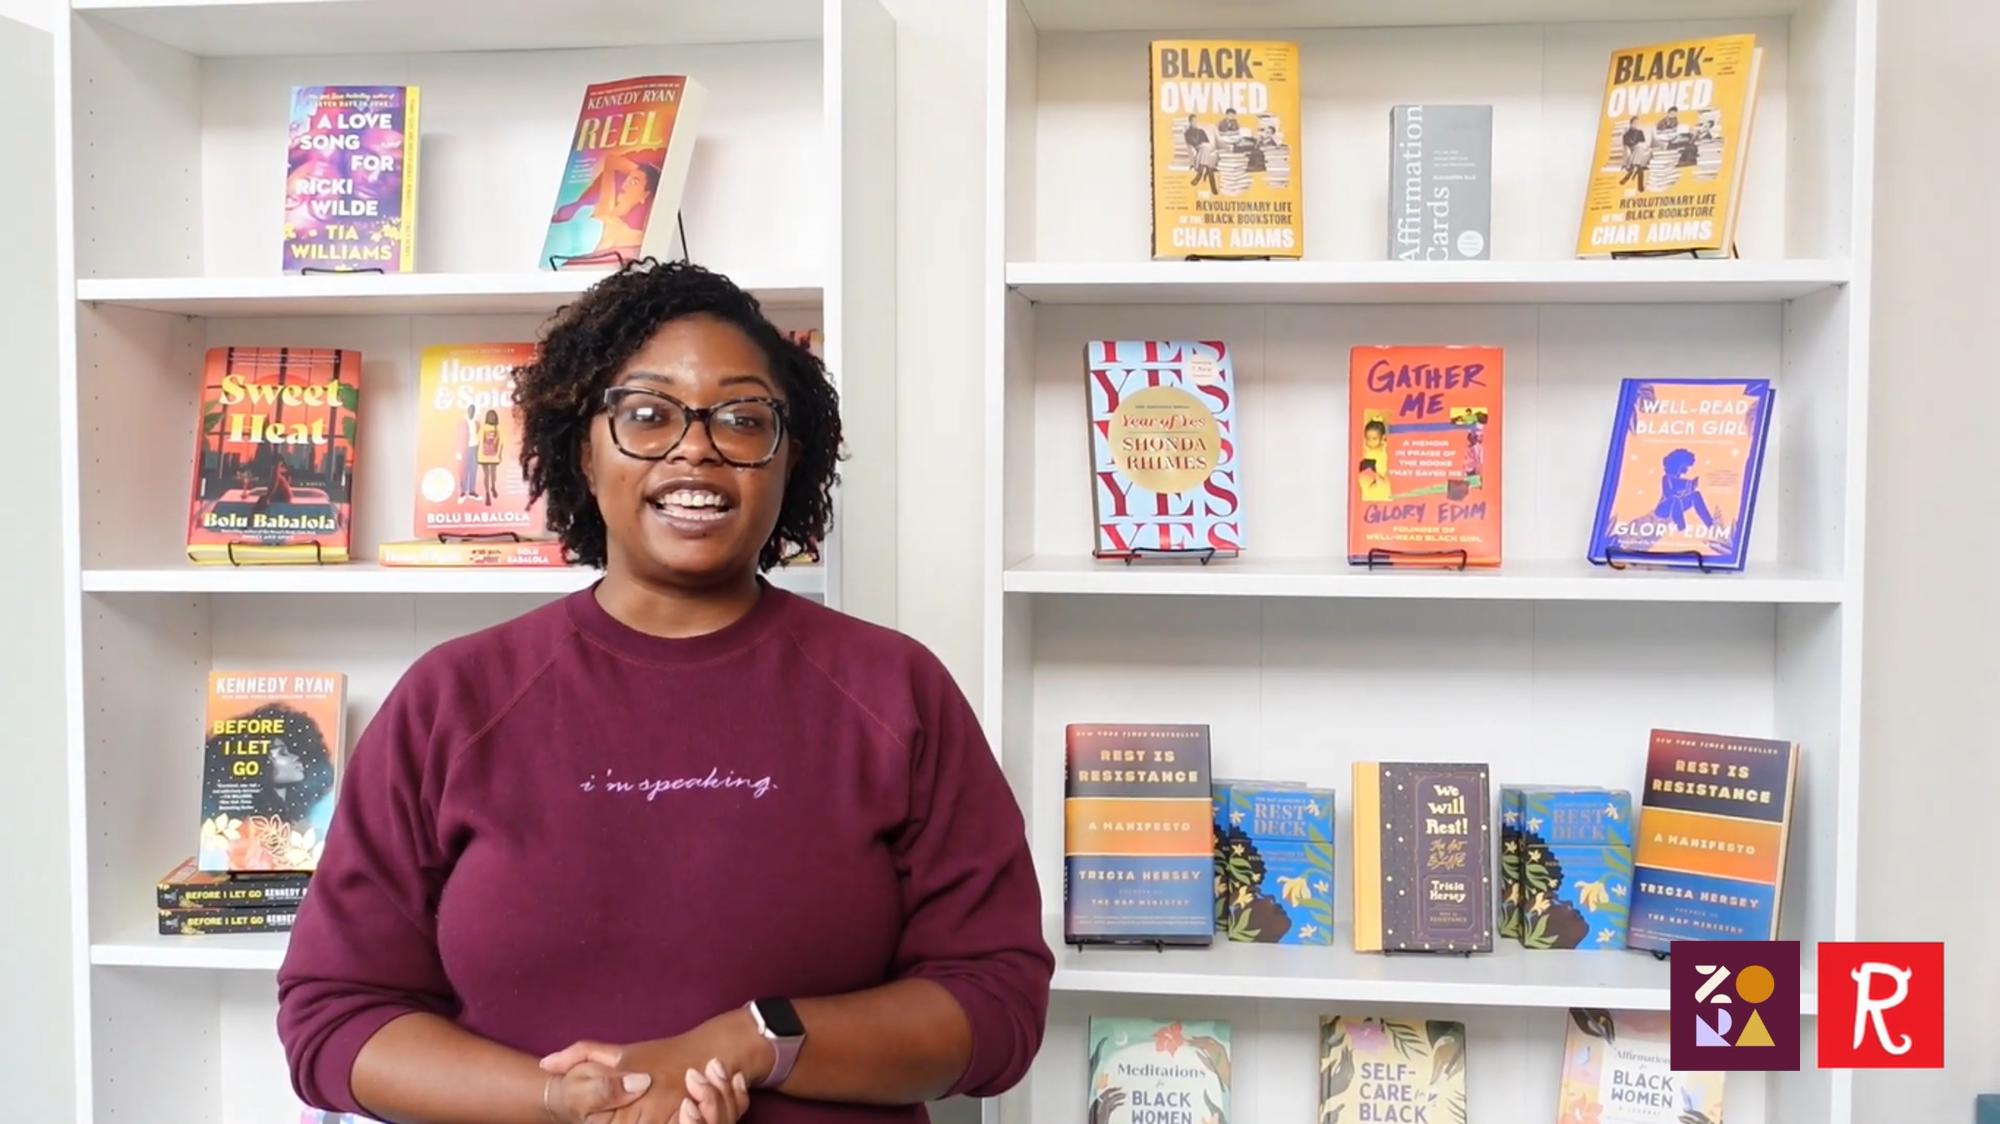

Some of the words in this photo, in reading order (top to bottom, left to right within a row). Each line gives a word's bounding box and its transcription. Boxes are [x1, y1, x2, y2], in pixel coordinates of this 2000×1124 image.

[1160, 48, 1263, 79] BLACK-
[1614, 46, 1714, 85] BLACK-
[588, 90, 641, 110] KENNEDY
[642, 89, 676, 103] RYAN
[1160, 82, 1269, 114] OWNED
[1607, 78, 1713, 118] OWNED
[317, 114, 332, 129] A
[337, 113, 392, 129] LOVE
[576, 111, 663, 152] REEL
[300, 134, 360, 150] SONG
[351, 156, 394, 171] FOR
[296, 179, 353, 194] RICKI
[1397, 105, 1422, 262] Affirmation
[1198, 190, 1210, 198] THE
[1620, 194, 1694, 208] REVOLUTIONARY
[1696, 194, 1717, 205] LIFE
[311, 200, 379, 216] WILDE
[1196, 201, 1271, 212] REVOLUTIONARY
[1273, 201, 1292, 212] LIFE
[1625, 209, 1655, 221] BLACK
[1658, 206, 1714, 218] BOOKSTORE
[1190, 215, 1203, 224] THE
[1204, 213, 1234, 224] BLACK
[1238, 214, 1292, 224] BOOKSTORE
[1426, 186, 1450, 262] Cards
[326, 225, 359, 240] TIA
[1172, 228, 1222, 248] CHAR
[1230, 228, 1294, 248] ADAMS
[1591, 225, 1640, 246] CHAR
[1646, 220, 1713, 244] ADAMS
[291, 244, 392, 260] WILLIAMS
[1367, 360, 1487, 393] GATHER
[219, 374, 343, 407] Sweet
[434, 386, 454, 410] &
[457, 385, 517, 411] Spic
[1400, 392, 1445, 419] ME
[1642, 400, 1749, 415] WELL-READ
[227, 414, 328, 444] Heat
[1122, 414, 1157, 428] Year
[1160, 413, 1178, 430] of
[1181, 414, 1206, 428] Yes
[1636, 420, 1696, 435] BLACK
[1702, 420, 1748, 436] GIRL
[1122, 437, 1207, 451] SHONDA
[1126, 456, 1208, 470] RHIMES
[426, 513, 461, 524] BOLU
[464, 512, 530, 523] BABALOLA
[1364, 503, 1426, 524] GLORY
[1438, 502, 1486, 524] EDIM
[203, 513, 248, 528] Bolu
[253, 514, 336, 530] Babalola
[1366, 534, 1424, 542] WELL-READ
[1392, 526, 1440, 534] FOUNDER
[1443, 526, 1456, 534] OF
[1614, 522, 1679, 538] GLORY
[1684, 524, 1731, 540] EDIM
[508, 556, 548, 564] BABALOLA
[516, 548, 538, 556] BOLU
[216, 677, 288, 694] KENNEDY
[294, 676, 335, 693] RYAN
[213, 719, 286, 735] BEFORE
[224, 740, 230, 755] I
[236, 740, 272, 755] LET
[1676, 739, 1696, 747] YORK
[1700, 742, 1725, 750] TIMES
[1727, 744, 1778, 755] BESTSELLER
[1100, 750, 1146, 762] REST
[1154, 750, 1176, 762] IS
[232, 761, 260, 776] GO
[1078, 770, 1199, 783] RESISTANCE
[1675, 759, 1720, 776] REST
[1727, 765, 1750, 779] IS
[1433, 785, 1460, 796] We
[1652, 778, 1772, 804] RESISTANCE
[1254, 804, 1308, 820] REST
[1427, 796, 1466, 814] will
[1553, 809, 1602, 825] REST
[1088, 822, 1097, 830] A
[1103, 822, 1190, 831] MANIFESTO
[1254, 820, 1306, 836] DECK
[1425, 818, 1468, 836] Rest!
[1552, 825, 1606, 840] DECK
[1654, 833, 1664, 843] A
[1668, 834, 1756, 855] MANIFESTO
[1078, 870, 1136, 881] TRICIA
[1142, 870, 1202, 881] HERSEY
[1430, 880, 1465, 891] Tricia
[185, 890, 221, 900] BEFORE
[224, 890, 227, 899] I
[230, 890, 246, 899] LET
[248, 890, 262, 898] GO
[264, 888, 300, 897] KENNEDY
[1430, 890, 1467, 903] Hersey
[1640, 882, 1694, 899] TRICIA
[1700, 891, 1760, 908] HERSEY
[187, 917, 223, 926] BEFORE
[225, 917, 229, 925] I
[231, 916, 248, 926] LET
[250, 916, 264, 925] GO
[1648, 913, 1665, 922] THE
[1668, 916, 1689, 925] NAP
[1692, 920, 1744, 934] MINISTRY
[1615, 1050, 1670, 1064] Affirmation
[1117, 1063, 1206, 1078] Meditations
[1361, 1062, 1416, 1082] SELF-
[1613, 1070, 1674, 1092] BLACK
[1132, 1090, 1192, 1108] BLACK
[1360, 1083, 1412, 1102] CARE
[1611, 1088, 1673, 1108] WOMEN
[1132, 1110, 1192, 1124] WOMEN
[1359, 1103, 1428, 1124] BLACK
